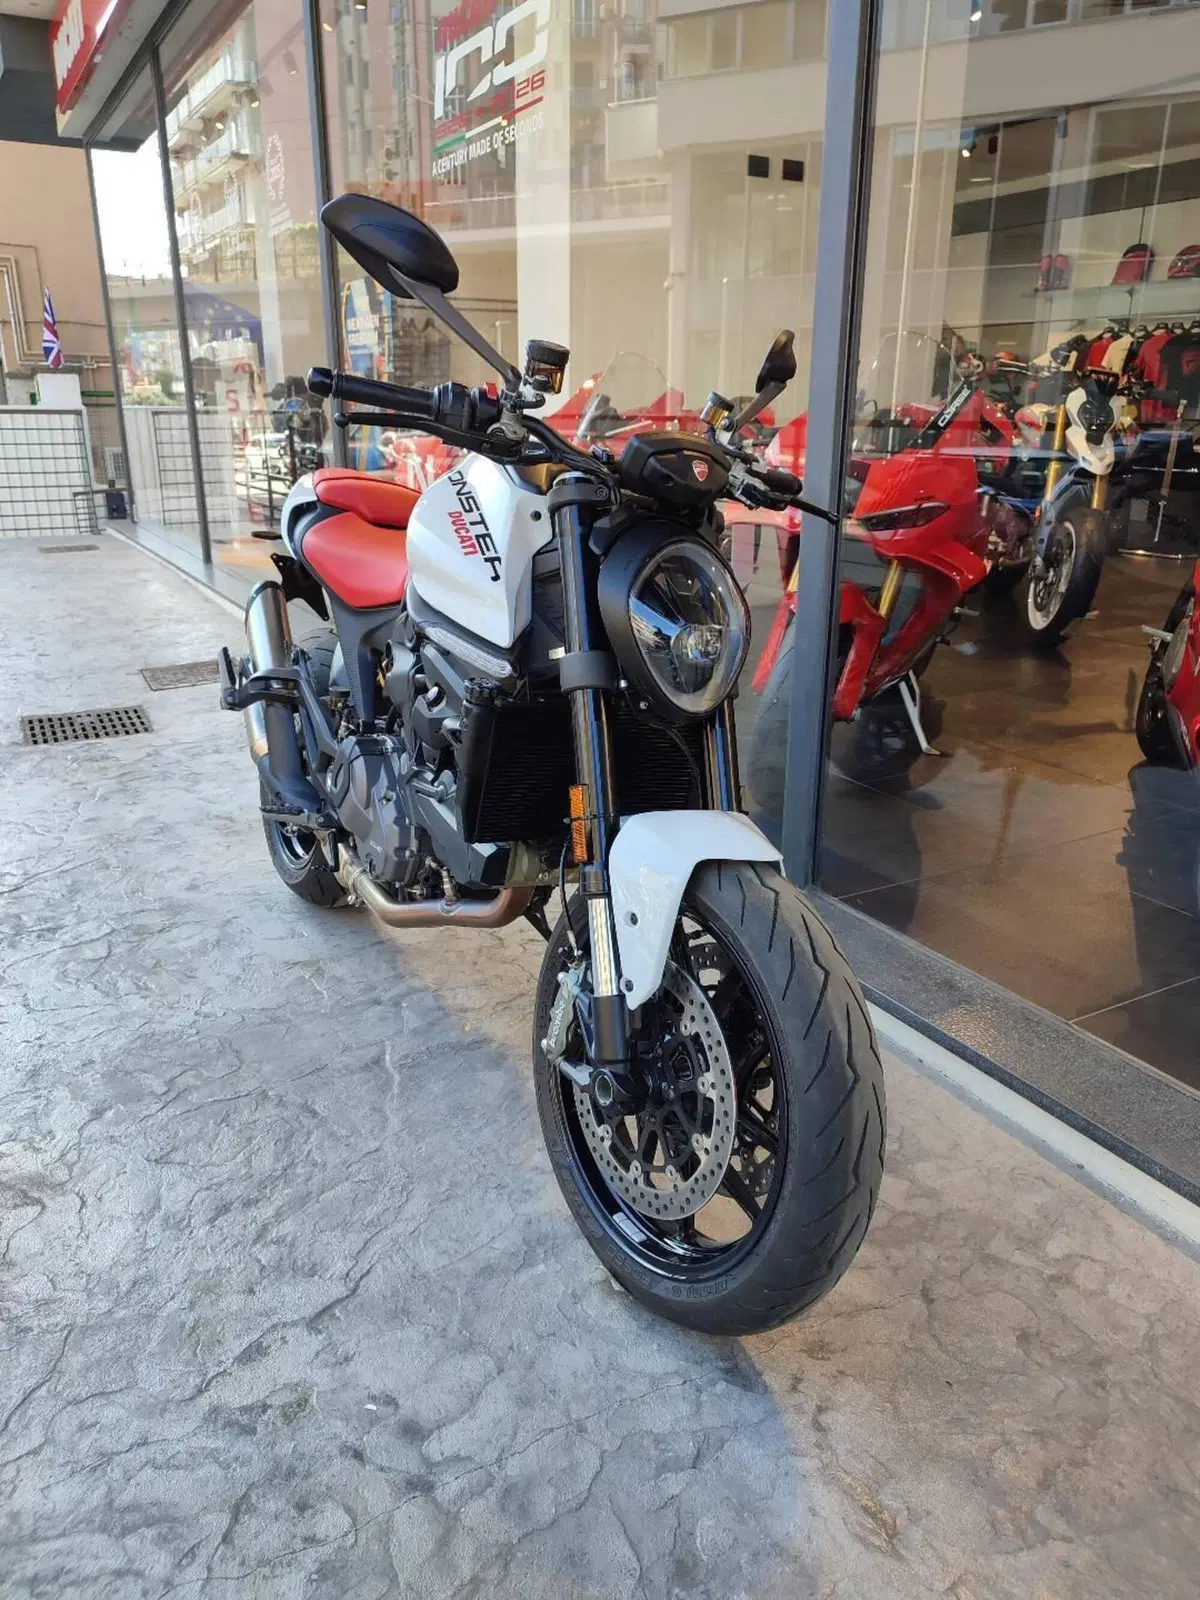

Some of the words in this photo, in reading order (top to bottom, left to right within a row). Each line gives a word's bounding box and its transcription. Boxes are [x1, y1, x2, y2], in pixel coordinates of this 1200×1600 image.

[432, 161, 439, 177] A
[437, 146, 469, 175] CENTURY
[469, 135, 491, 161] MADE
[492, 129, 504, 149] OF
[504, 112, 545, 145] SECONDS
[447, 470, 502, 582] ONSTER
[447, 511, 478, 557] DUCATI
